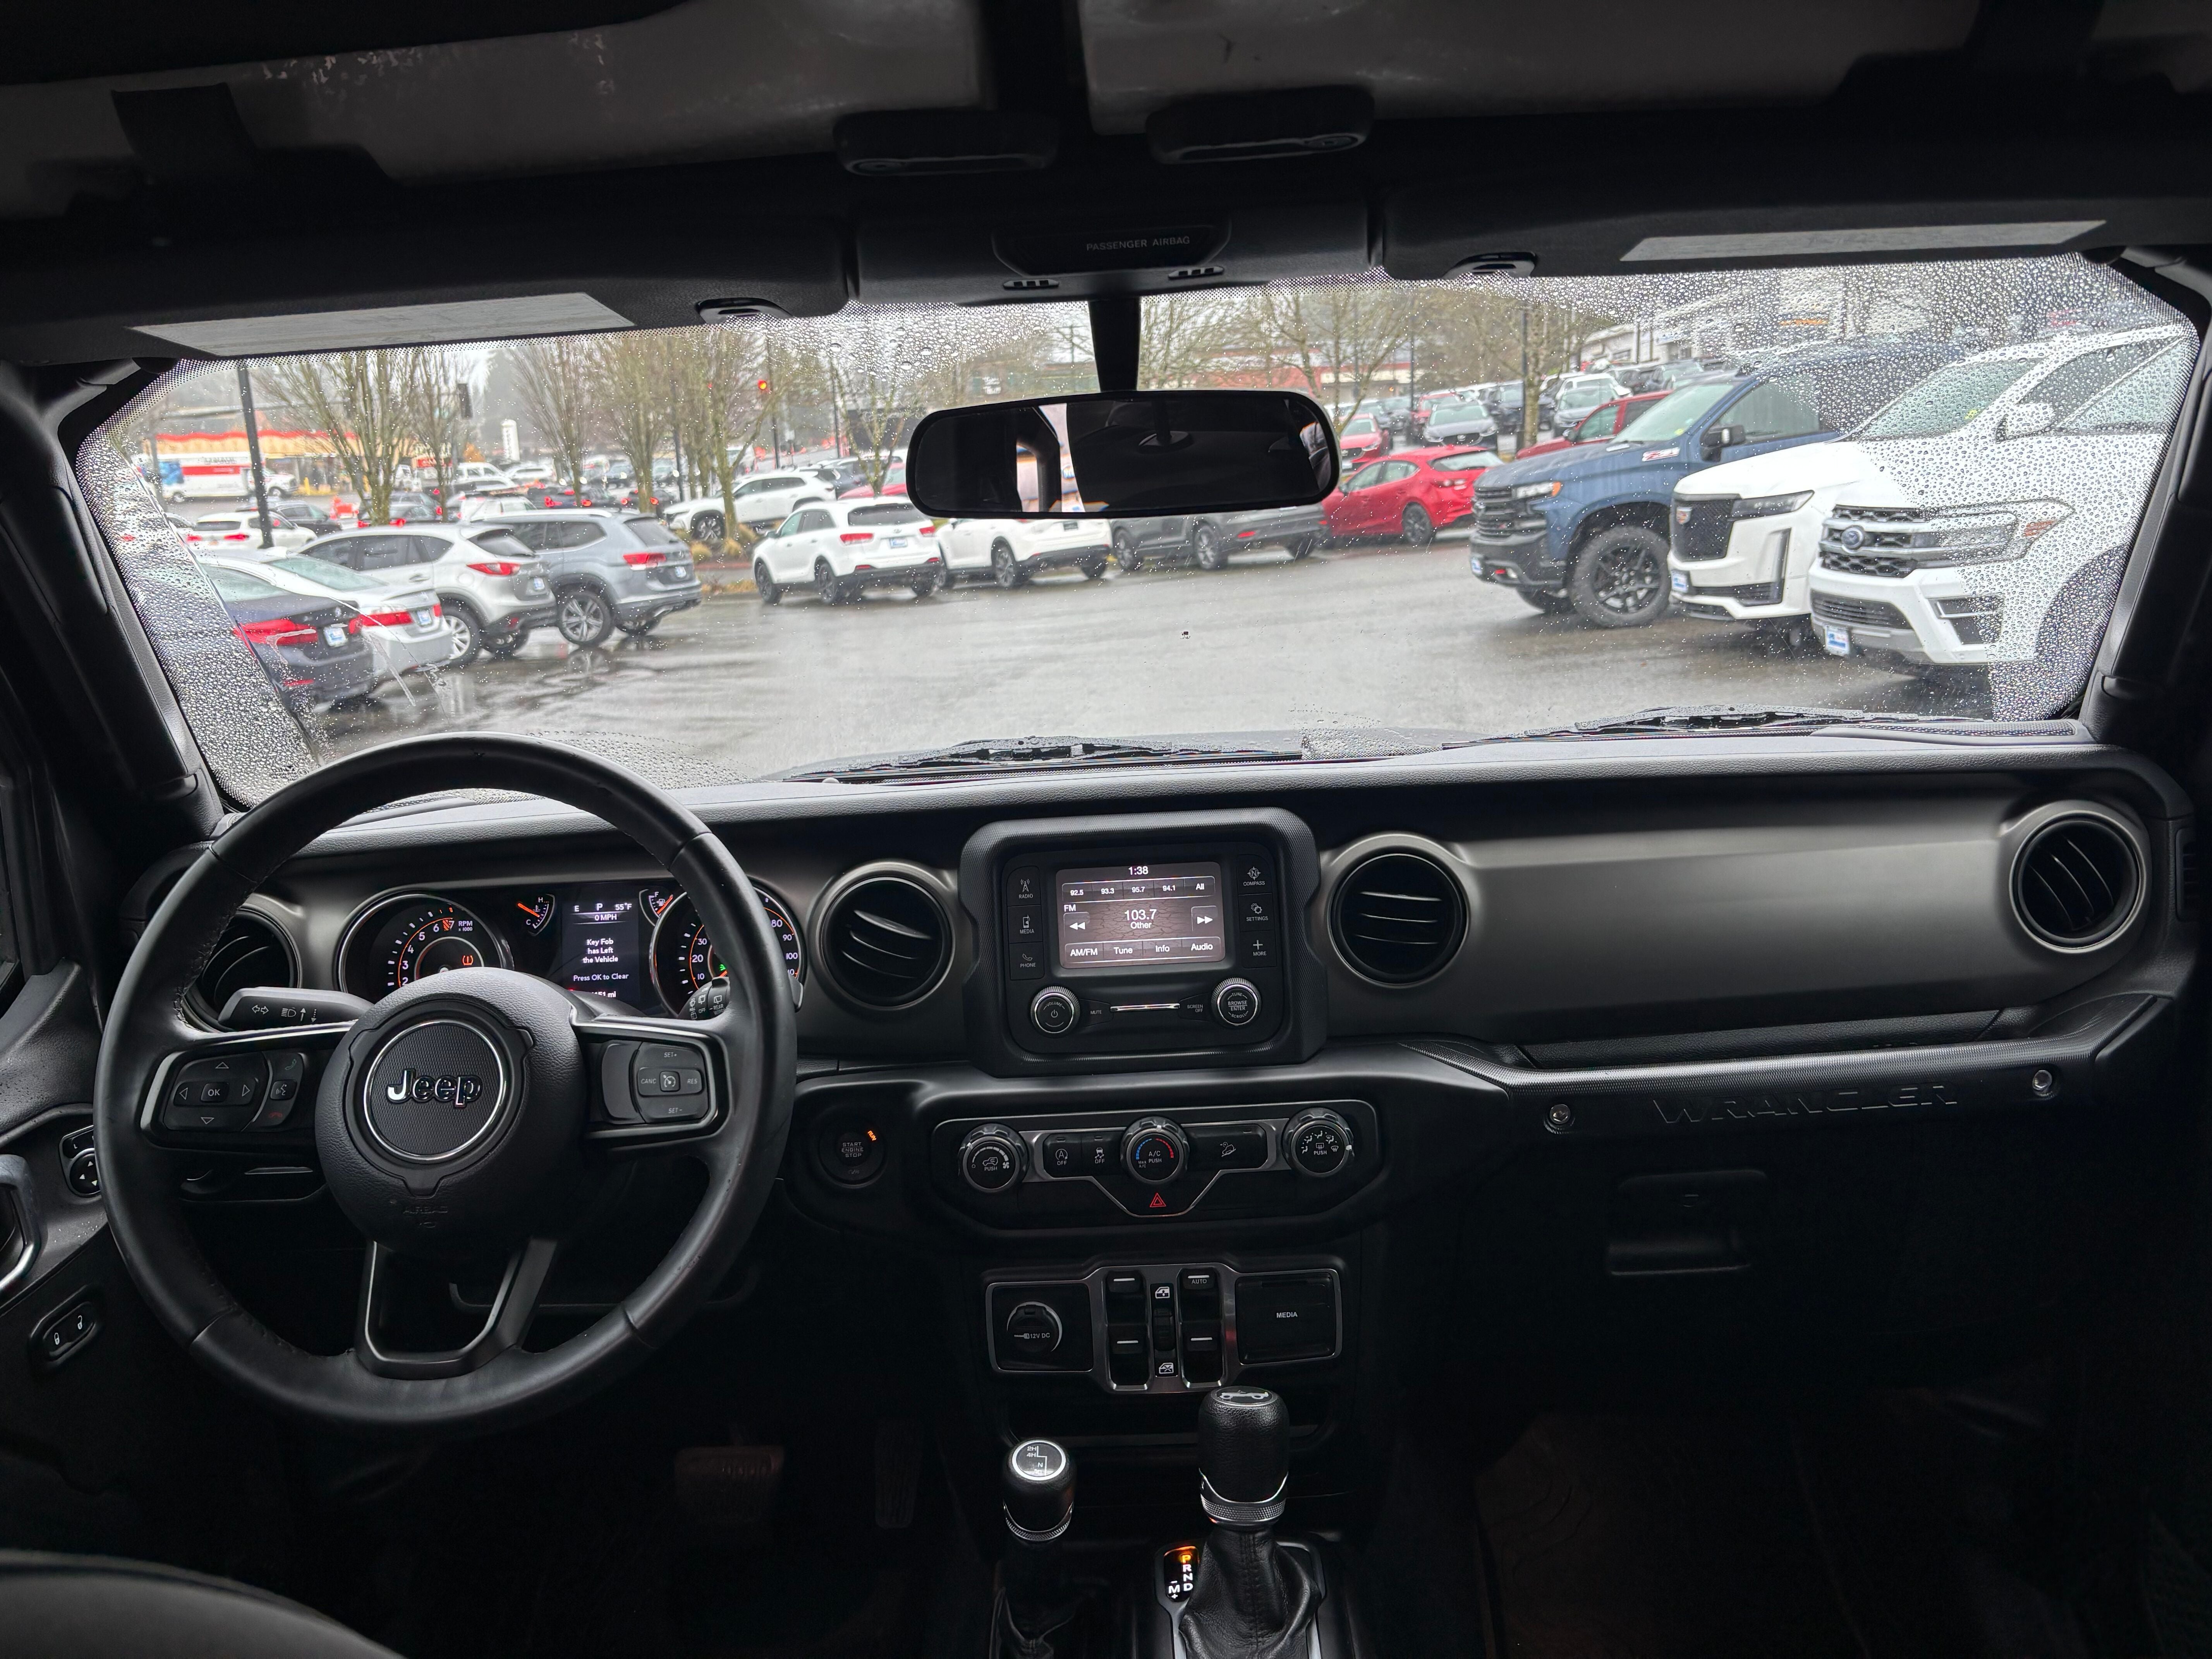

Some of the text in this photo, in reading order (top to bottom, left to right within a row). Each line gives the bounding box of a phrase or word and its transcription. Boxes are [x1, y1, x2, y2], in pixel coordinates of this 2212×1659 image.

[1086, 235, 1190, 251] PASSENGER AIRBAG
[1128, 866, 1149, 875] 1:38
[1124, 909, 1157, 921] 103.7
[448, 920, 455, 930] 7
[771, 919, 783, 927] 80
[433, 924, 440, 933] 6
[419, 932, 425, 941] 5
[407, 945, 414, 953] 4
[1070, 948, 1098, 957] AM/FM
[1155, 945, 1170, 953] Info
[1191, 943, 1213, 951] Audio
[692, 954, 704, 963] 20
[402, 960, 409, 970] 3
[402, 977, 409, 986] 2
[387, 1069, 483, 1107] Jeep
[1182, 1554, 1191, 1564] P
[1182, 1564, 1192, 1572] R
[1183, 1573, 1193, 1582] N
[1168, 1584, 1180, 1594] M
[1183, 1583, 1194, 1592] D
